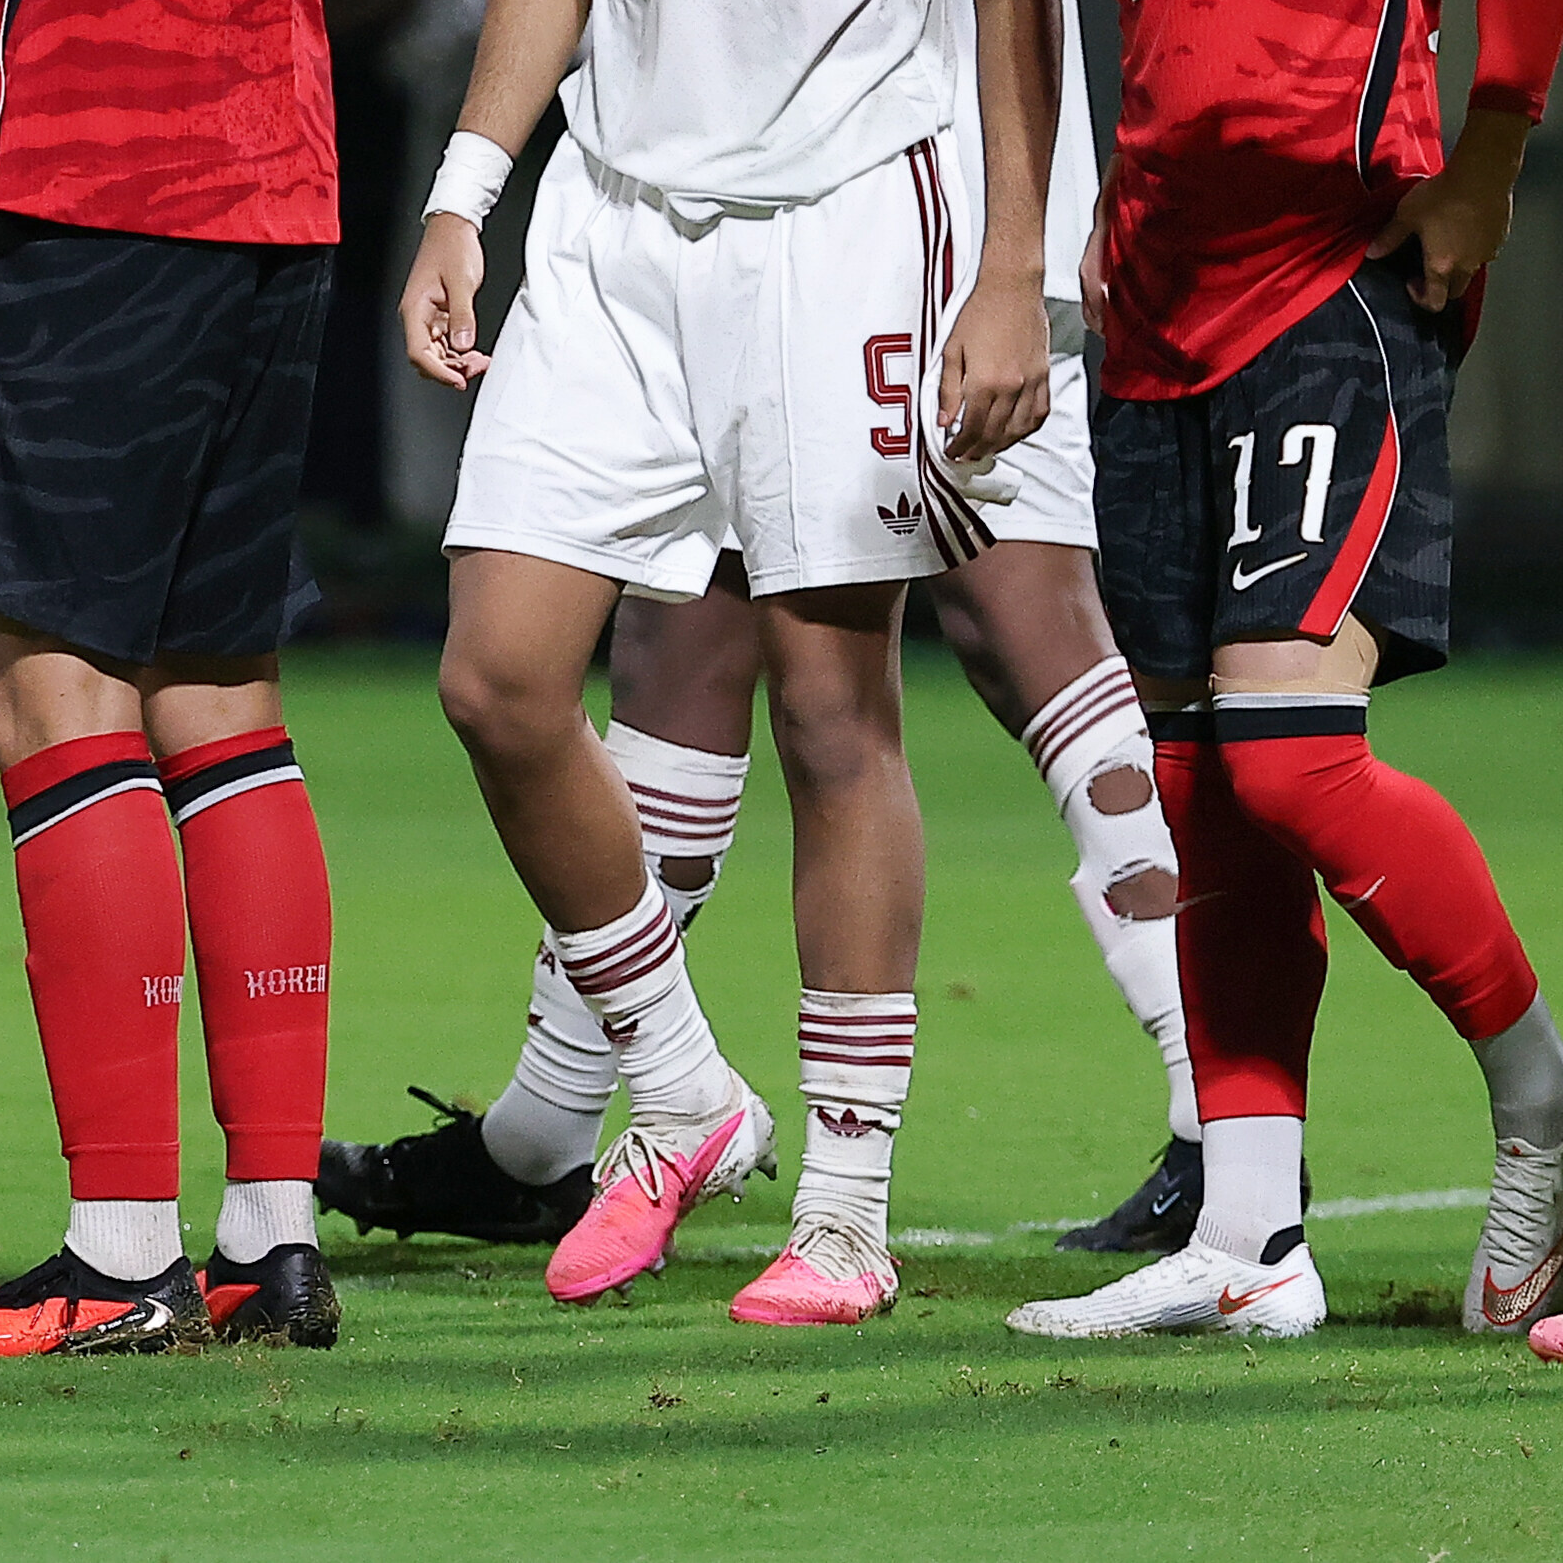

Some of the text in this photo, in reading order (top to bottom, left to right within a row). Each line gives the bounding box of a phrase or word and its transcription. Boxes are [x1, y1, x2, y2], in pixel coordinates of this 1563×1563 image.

[863, 333, 913, 460] 5
[1227, 423, 1337, 553] 17
[244, 964, 326, 999] KOREA
